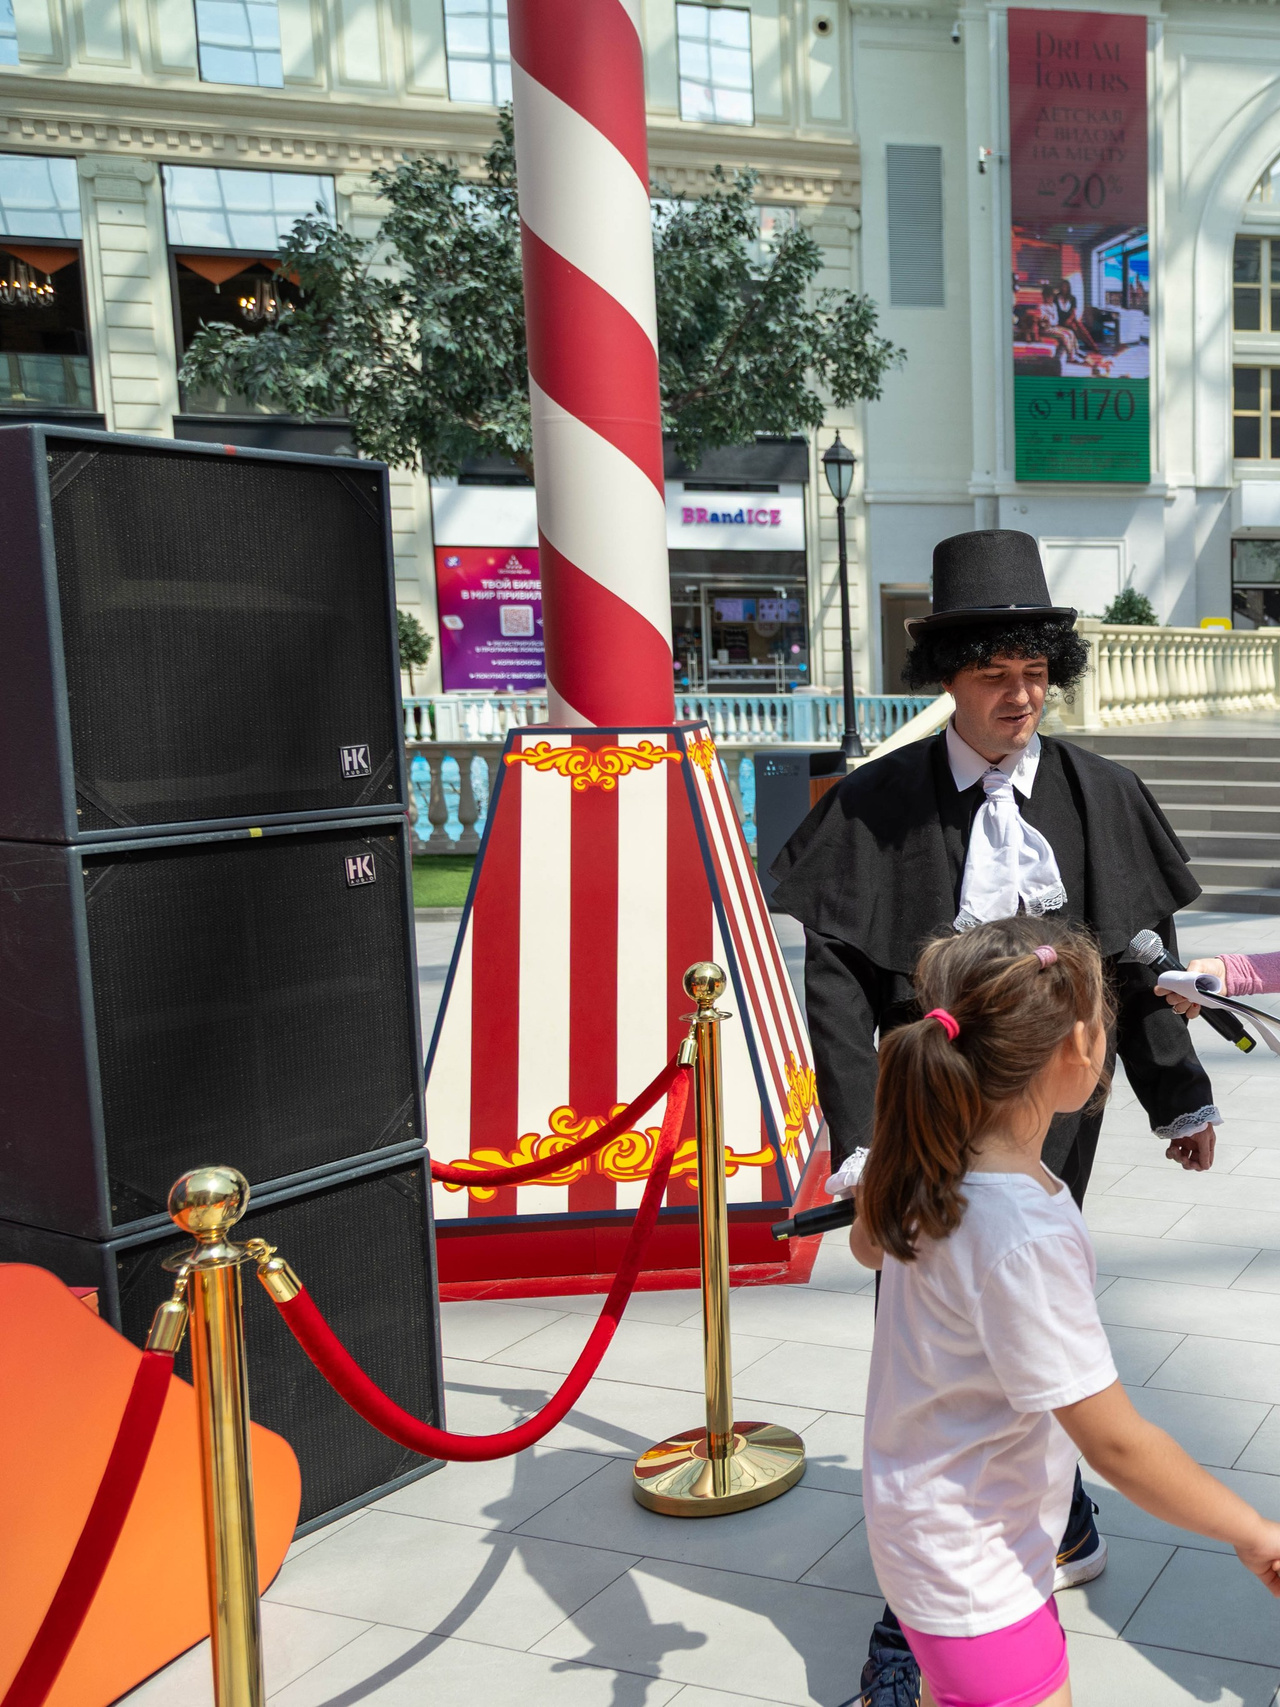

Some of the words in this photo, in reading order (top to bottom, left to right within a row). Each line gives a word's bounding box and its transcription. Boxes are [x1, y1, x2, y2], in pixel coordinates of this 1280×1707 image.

[1036, 106, 1123, 124] ДЕТСКАЯ
[1063, 146, 1126, 162] МЕЧТУ
[682, 506, 781, 526] BRandICE
[481, 577, 512, 589] ТВОЙ
[461, 590, 470, 600] В
[471, 590, 496, 600] МИР
[343, 748, 368, 771] HK
[348, 855, 374, 880] HK
